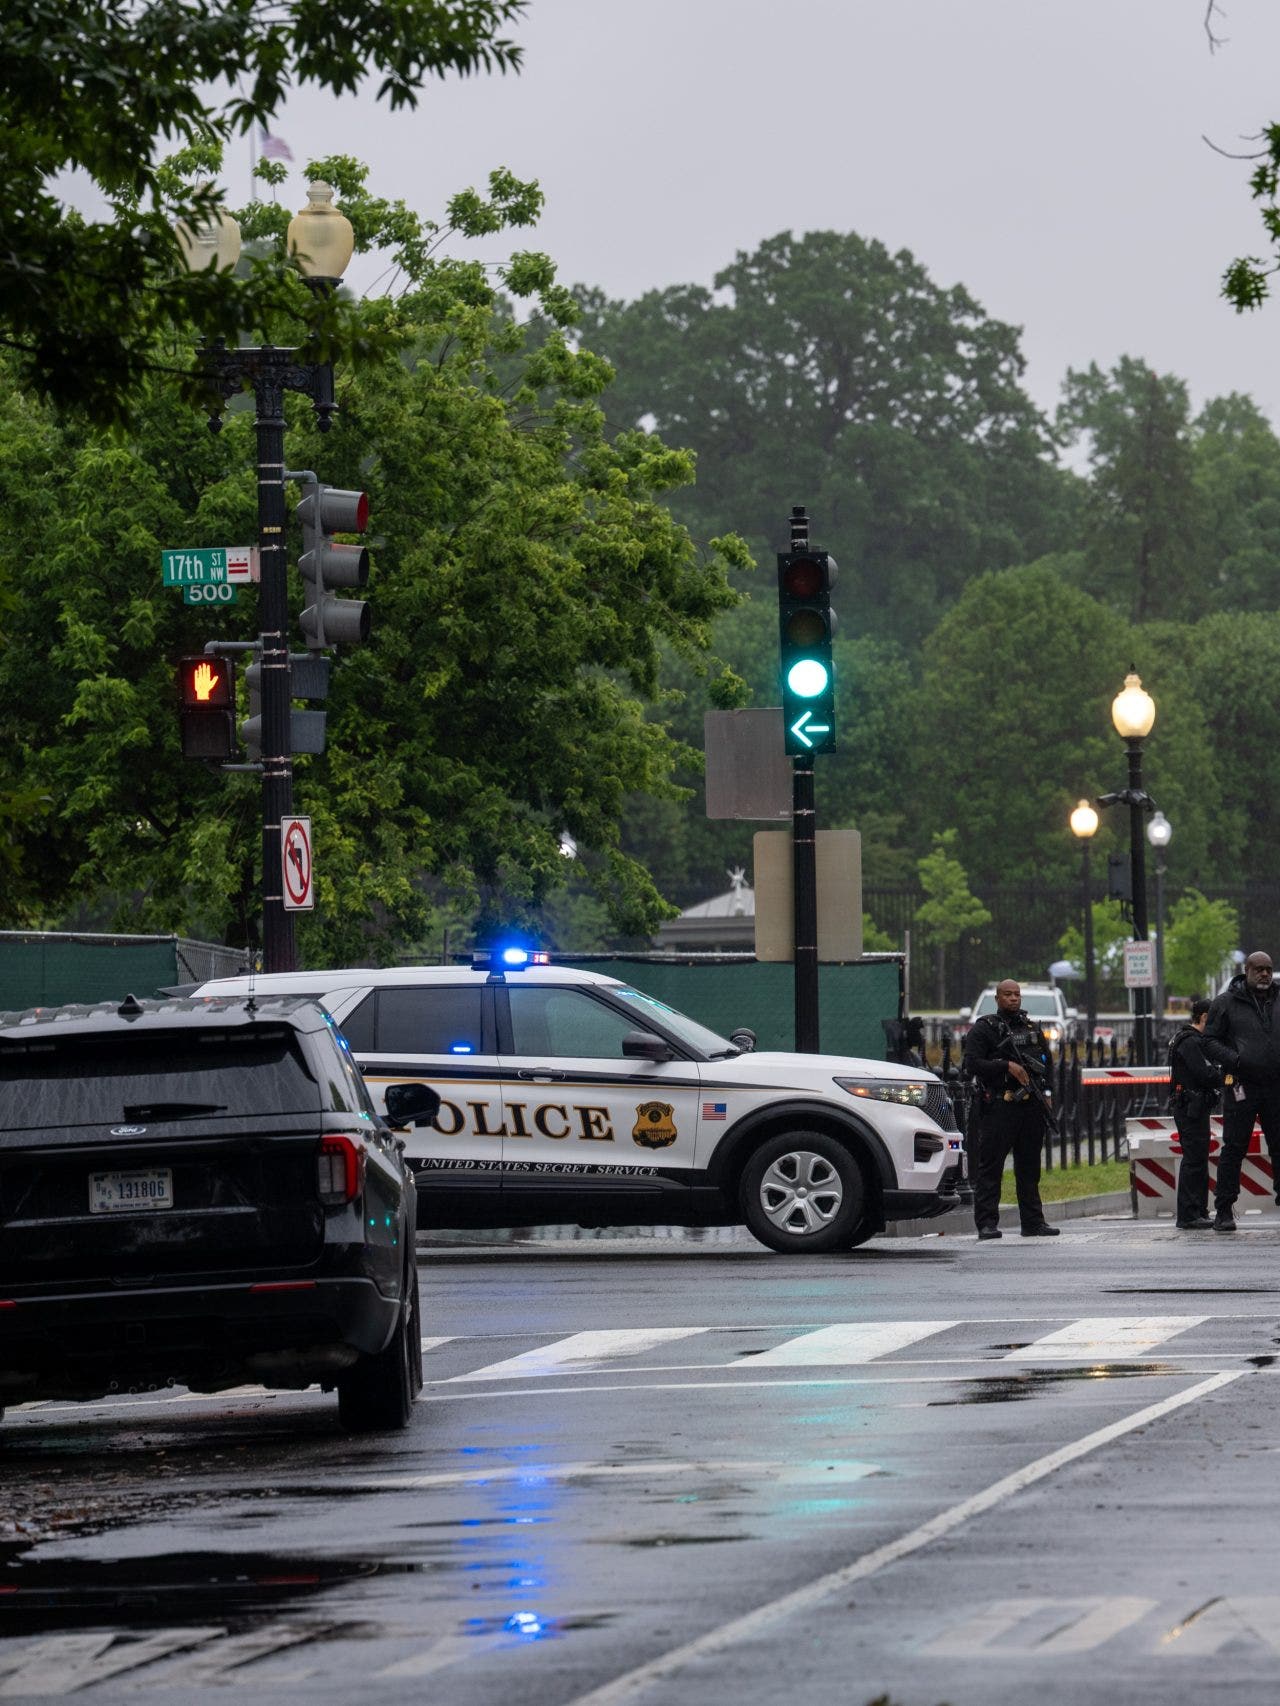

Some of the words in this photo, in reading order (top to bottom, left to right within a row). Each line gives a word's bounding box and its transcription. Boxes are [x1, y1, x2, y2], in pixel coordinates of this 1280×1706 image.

[168, 554, 204, 580] 17th
[211, 552, 222, 566] ST
[210, 567, 224, 581] NW
[189, 584, 233, 602] 500
[390, 1100, 616, 1142] OLICE
[420, 1159, 475, 1169] UNITED
[478, 1160, 531, 1171] STATES
[534, 1162, 592, 1174] SECRET
[596, 1165, 659, 1176] SERVICE
[118, 1180, 165, 1200] 131806
